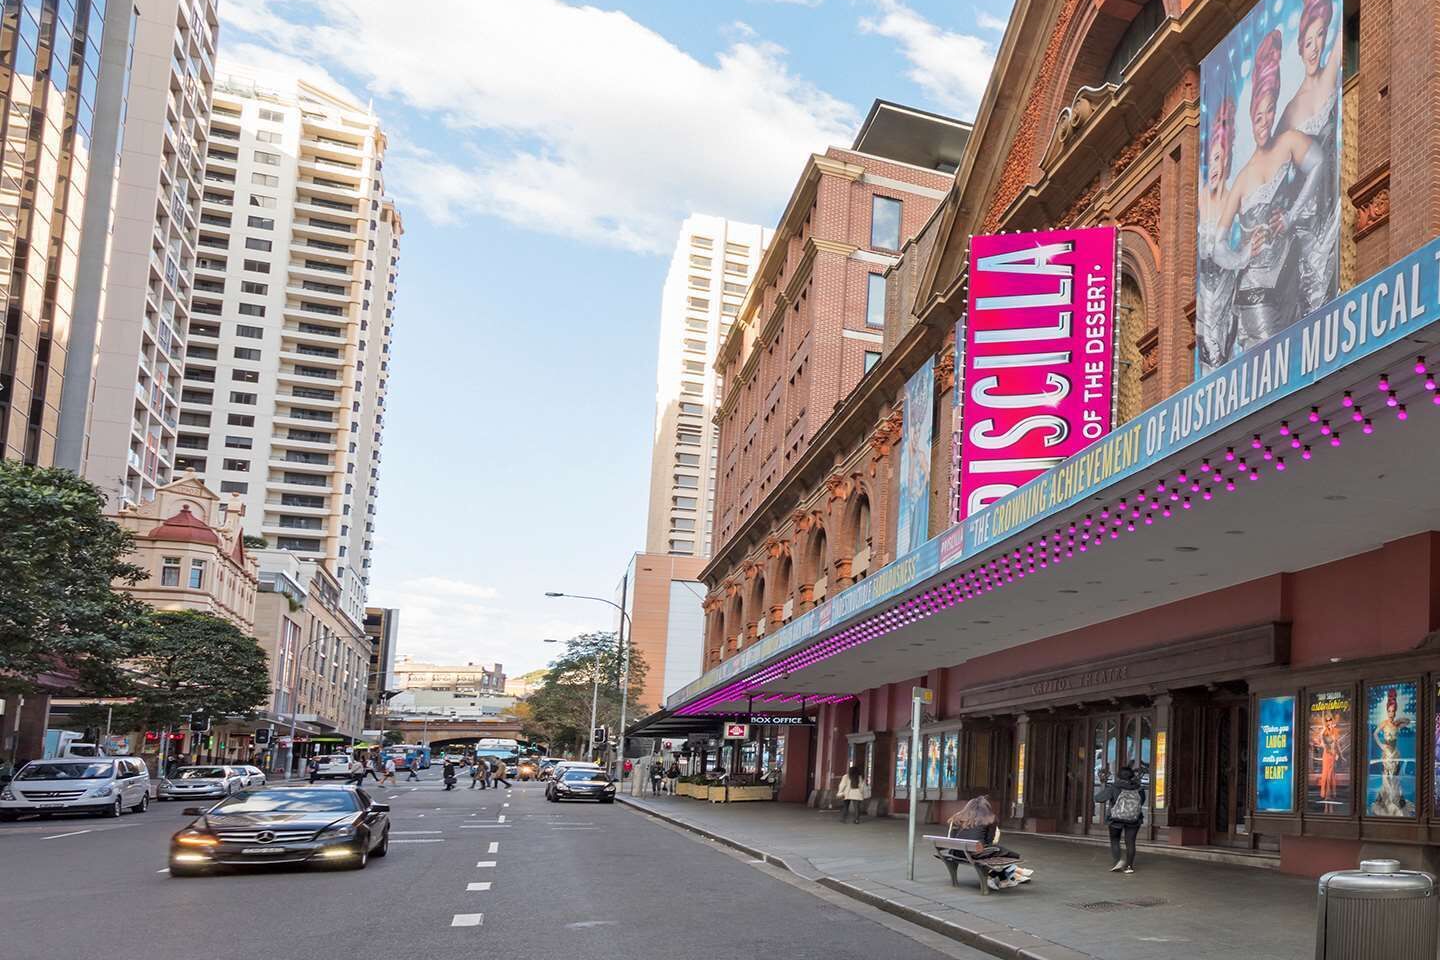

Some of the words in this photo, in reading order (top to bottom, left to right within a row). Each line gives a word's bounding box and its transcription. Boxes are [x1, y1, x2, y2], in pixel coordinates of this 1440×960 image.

[966, 243, 1074, 518] ISCILLA
[992, 480, 1048, 536] CROWNING
[1049, 424, 1142, 510] ACHIEVEMENT
[1146, 408, 1168, 456] OF
[1169, 338, 1289, 444] AUSTRALIAN
[1301, 263, 1425, 376] MUSICAL
[1084, 361, 1104, 403] THE
[1083, 409, 1103, 439] OF
[1265, 735, 1287, 748] LAUGH
